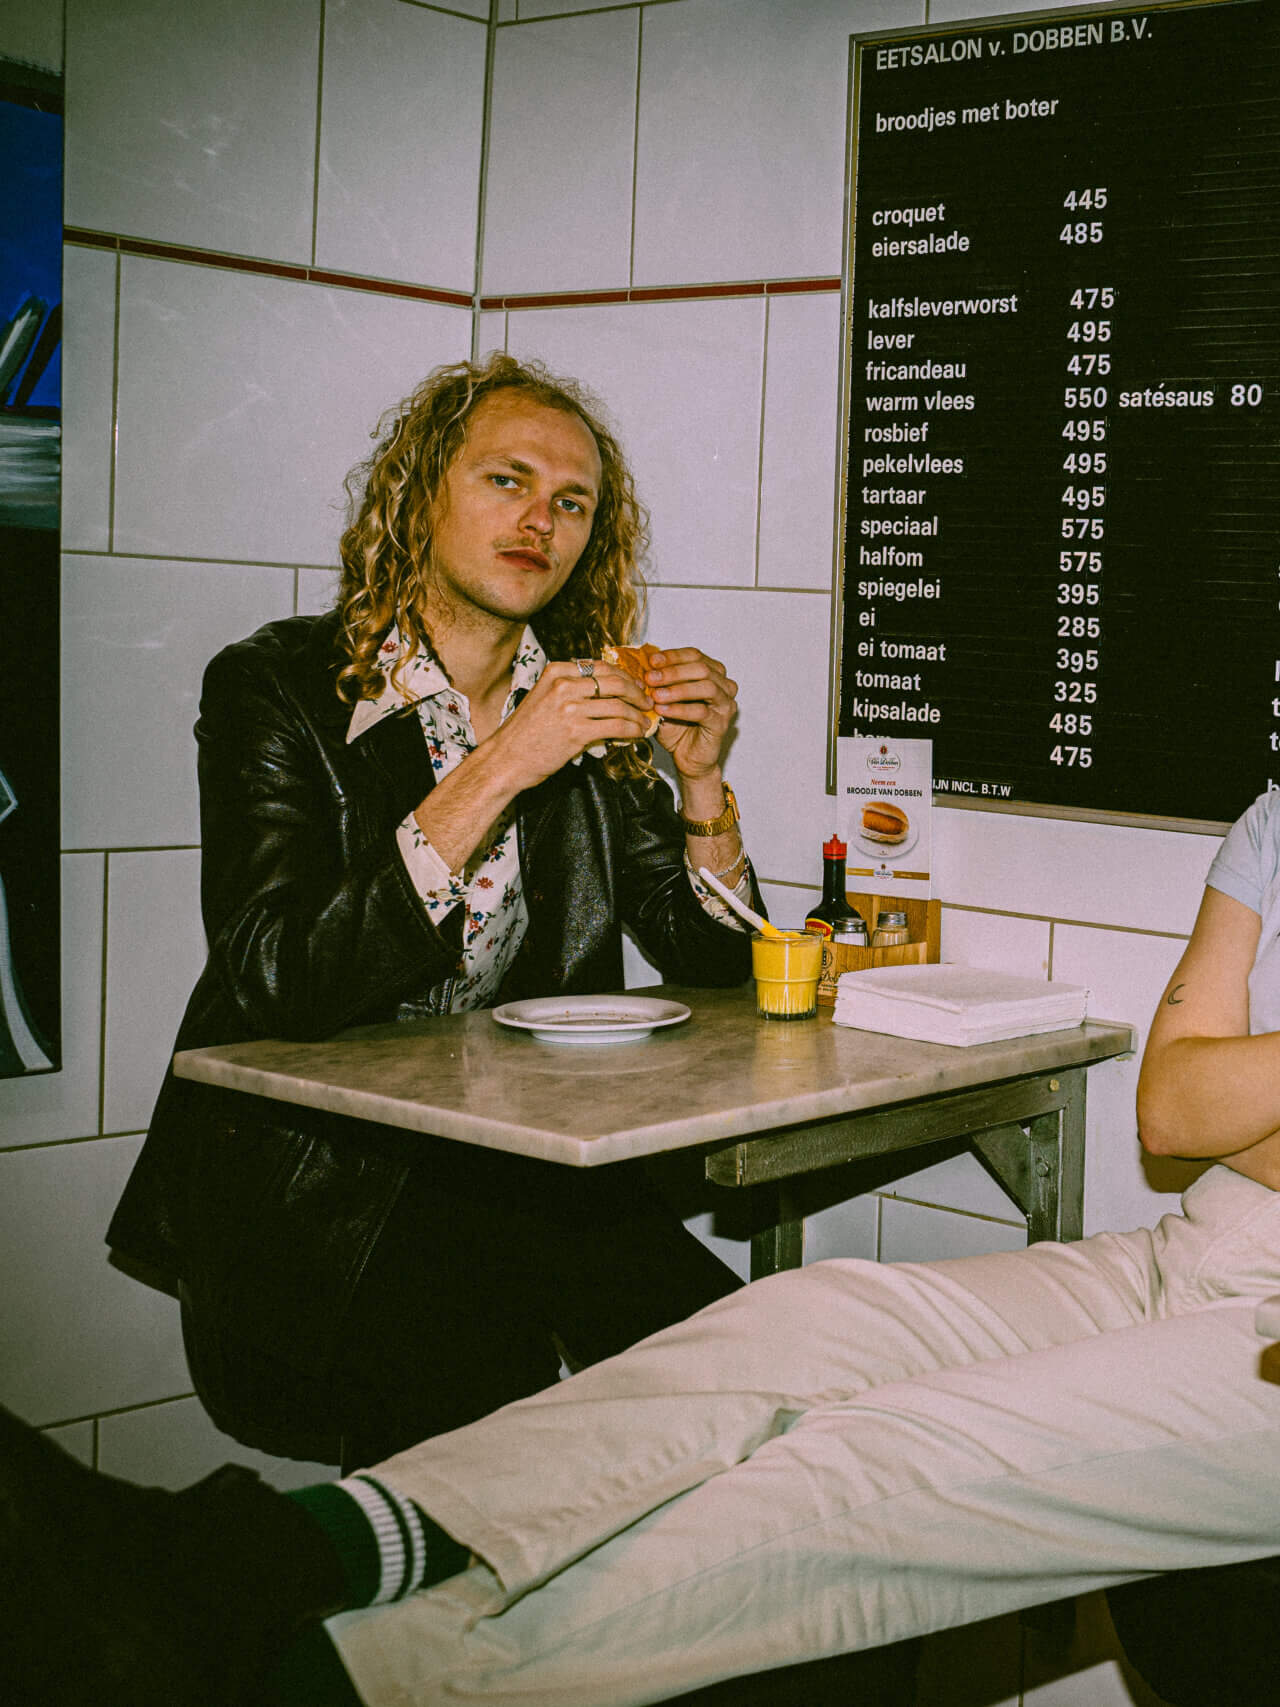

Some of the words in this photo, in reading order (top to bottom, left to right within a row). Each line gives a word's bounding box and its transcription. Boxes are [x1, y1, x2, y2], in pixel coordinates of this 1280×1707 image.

[877, 38, 981, 70] EETSALON
[989, 41, 1005, 56] v.
[1013, 21, 1103, 53] DOBBEN
[1111, 18, 1152, 42] B.V.
[876, 107, 956, 132] broodjes
[962, 103, 999, 123] met
[1006, 99, 1059, 119] boter
[873, 204, 945, 227] croquet
[1064, 188, 1107, 211] 445
[872, 231, 969, 257] eiersalade
[1060, 222, 1102, 244] 485
[869, 295, 1018, 318] kalfsleverworst
[1070, 288, 1114, 309] 475
[868, 330, 915, 349] lever
[1067, 321, 1110, 342] 495
[866, 360, 965, 380] fricandeau
[1067, 354, 1110, 375] 475
[866, 397, 918, 411] warm
[924, 391, 974, 410] vlees
[1065, 387, 1107, 408] 550
[1119, 383, 1213, 407] satésaus
[1231, 384, 1262, 406] 80
[865, 422, 928, 442] rosbief
[1062, 420, 1105, 441] 495
[863, 453, 963, 477] pekelvlees
[1063, 453, 1106, 473] 495
[862, 487, 926, 504] tartaar
[1062, 486, 1104, 510] 495
[861, 516, 938, 538] speciaal
[1062, 519, 1103, 539] 575
[860, 546, 922, 566] halfom
[1060, 552, 1101, 572] 575
[858, 577, 940, 601] spiegelei
[1057, 584, 1099, 605] 395
[859, 609, 875, 626] ei
[1058, 616, 1100, 638] 285
[858, 638, 874, 656] ei
[880, 641, 946, 661] tomaat
[1057, 648, 1098, 673] 395
[856, 670, 921, 691] tomaat
[1054, 681, 1096, 703] 325
[853, 698, 940, 723] kipsalade
[1049, 713, 1092, 735] 485
[1050, 746, 1092, 768] 475
[847, 787, 877, 795] BROODJE
[879, 788, 893, 796] VAN
[894, 788, 922, 797] DOBBEN
[932, 778, 949, 792] IJN
[952, 781, 978, 793] INCL.
